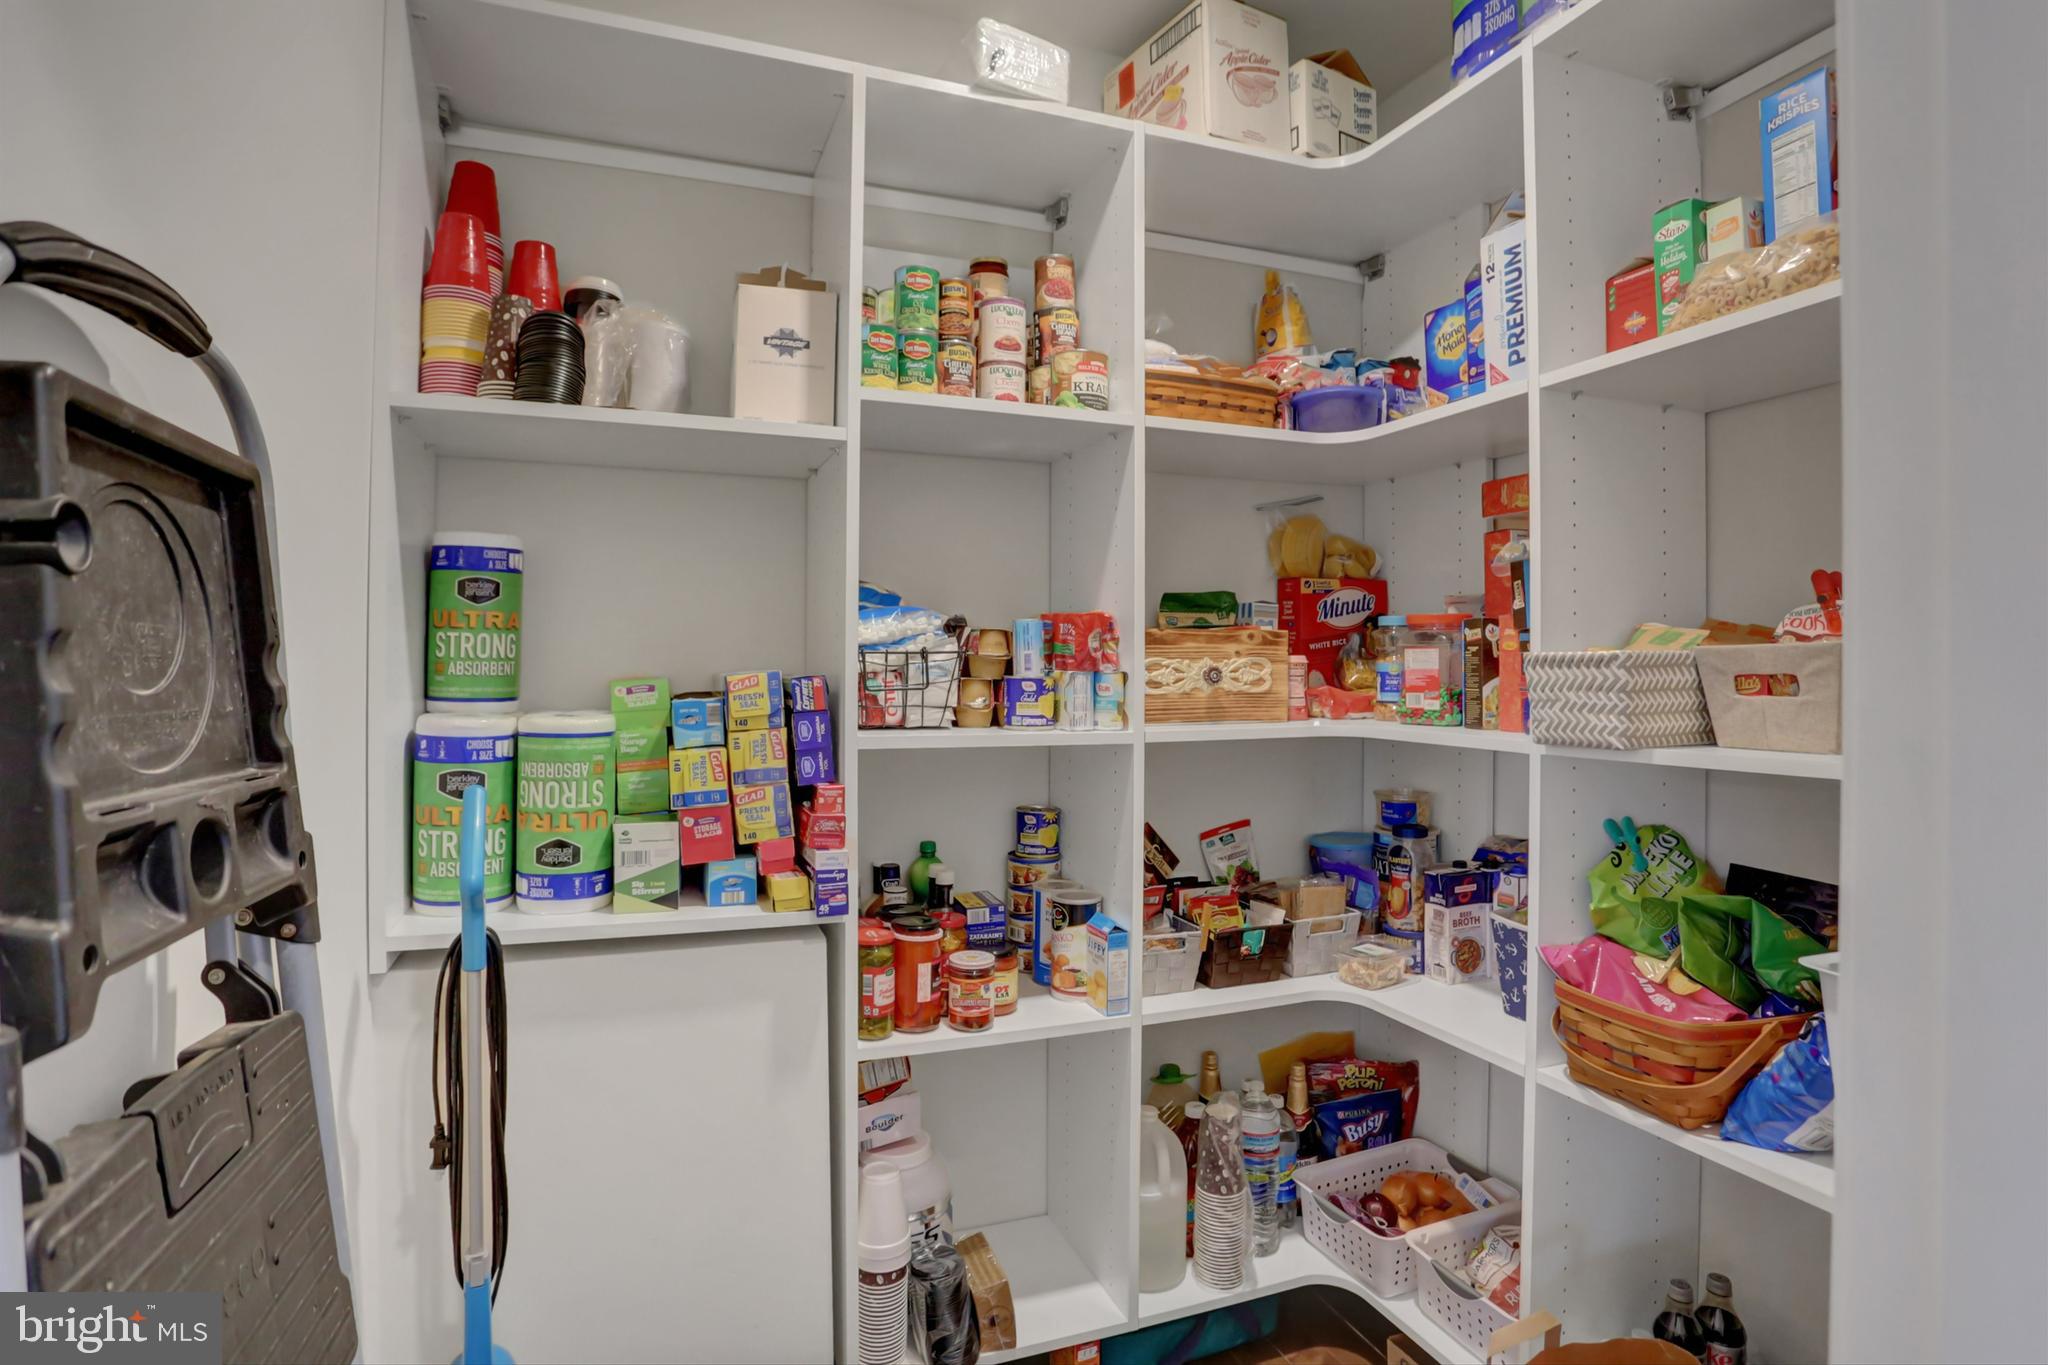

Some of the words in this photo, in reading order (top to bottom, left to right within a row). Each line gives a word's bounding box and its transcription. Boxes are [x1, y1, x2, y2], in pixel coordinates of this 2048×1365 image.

[1484, 4, 1515, 36] CHOOSE
[1219, 51, 1247, 66] Apple
[1248, 53, 1271, 65] Cider
[1778, 92, 1807, 114] RICE
[1767, 98, 1820, 133] KRISPIES
[1486, 262, 1495, 283] 12
[1504, 243, 1525, 368] PREMIUM
[1442, 334, 1467, 355] Maid
[1317, 592, 1376, 621] Minute
[433, 608, 520, 630] ULTRA
[435, 631, 516, 659] STRONG
[1309, 641, 1331, 651] WHITE
[1332, 638, 1348, 648] RICE
[447, 660, 516, 677] ABSORBENT
[729, 676, 759, 692] GLAD
[739, 701, 760, 709] SEAL
[466, 739, 494, 750] CHOOSE
[733, 737, 741, 751] 140
[771, 731, 784, 759] GLAD
[478, 751, 494, 761] SIZE
[673, 758, 681, 773] 140
[692, 762, 700, 781] SEAL
[710, 751, 724, 781] GLAD
[519, 780, 605, 809] STRONG
[736, 790, 765, 805] GLAD
[415, 803, 512, 827] ULTA
[518, 808, 609, 833] ULTRA
[745, 813, 765, 822] SEAL
[694, 822, 721, 833] STORAGE
[418, 826, 507, 860] STRNG
[744, 832, 757, 841] 140
[1647, 850, 1696, 898] LIME
[631, 887, 665, 896] Stirrers
[884, 880, 899, 888] Kraft
[529, 888, 554, 898] CHOOSE
[819, 904, 830, 912] 45
[1459, 910, 1473, 918] BEEF
[1452, 916, 1481, 928] BROTH
[969, 932, 1004, 941] ZATARAIN'S
[1087, 937, 1106, 955] JIFFY
[1337, 1077, 1386, 1091] Peroni
[865, 1112, 905, 1134] Boulder
[1343, 1112, 1384, 1142] Busy
